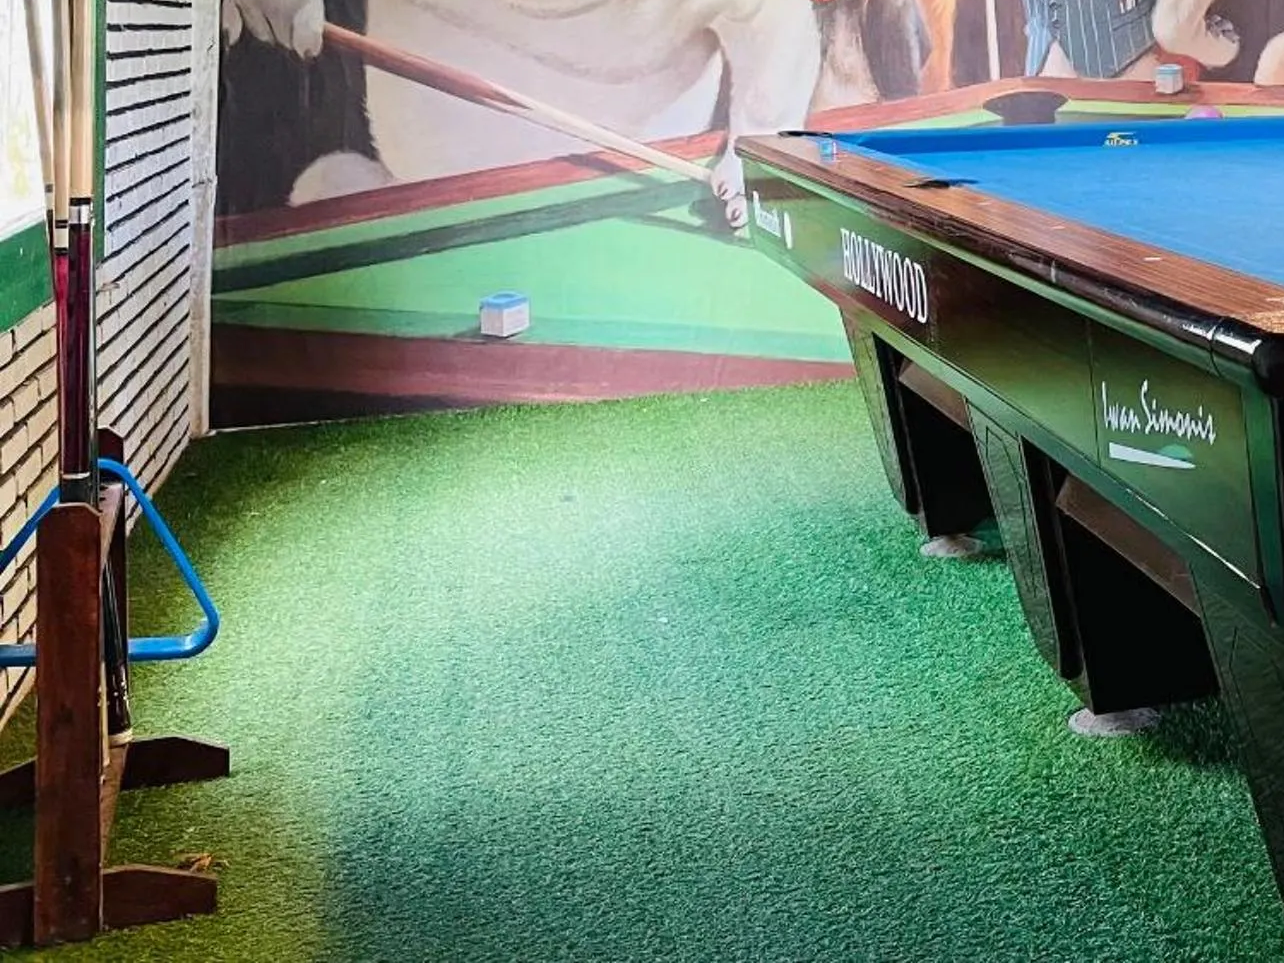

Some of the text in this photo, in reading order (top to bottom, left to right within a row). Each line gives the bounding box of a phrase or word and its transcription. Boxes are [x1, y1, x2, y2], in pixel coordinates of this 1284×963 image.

[840, 227, 928, 324] HOLLYWOOD
[1101, 378, 1217, 446] Iwan Simonis
